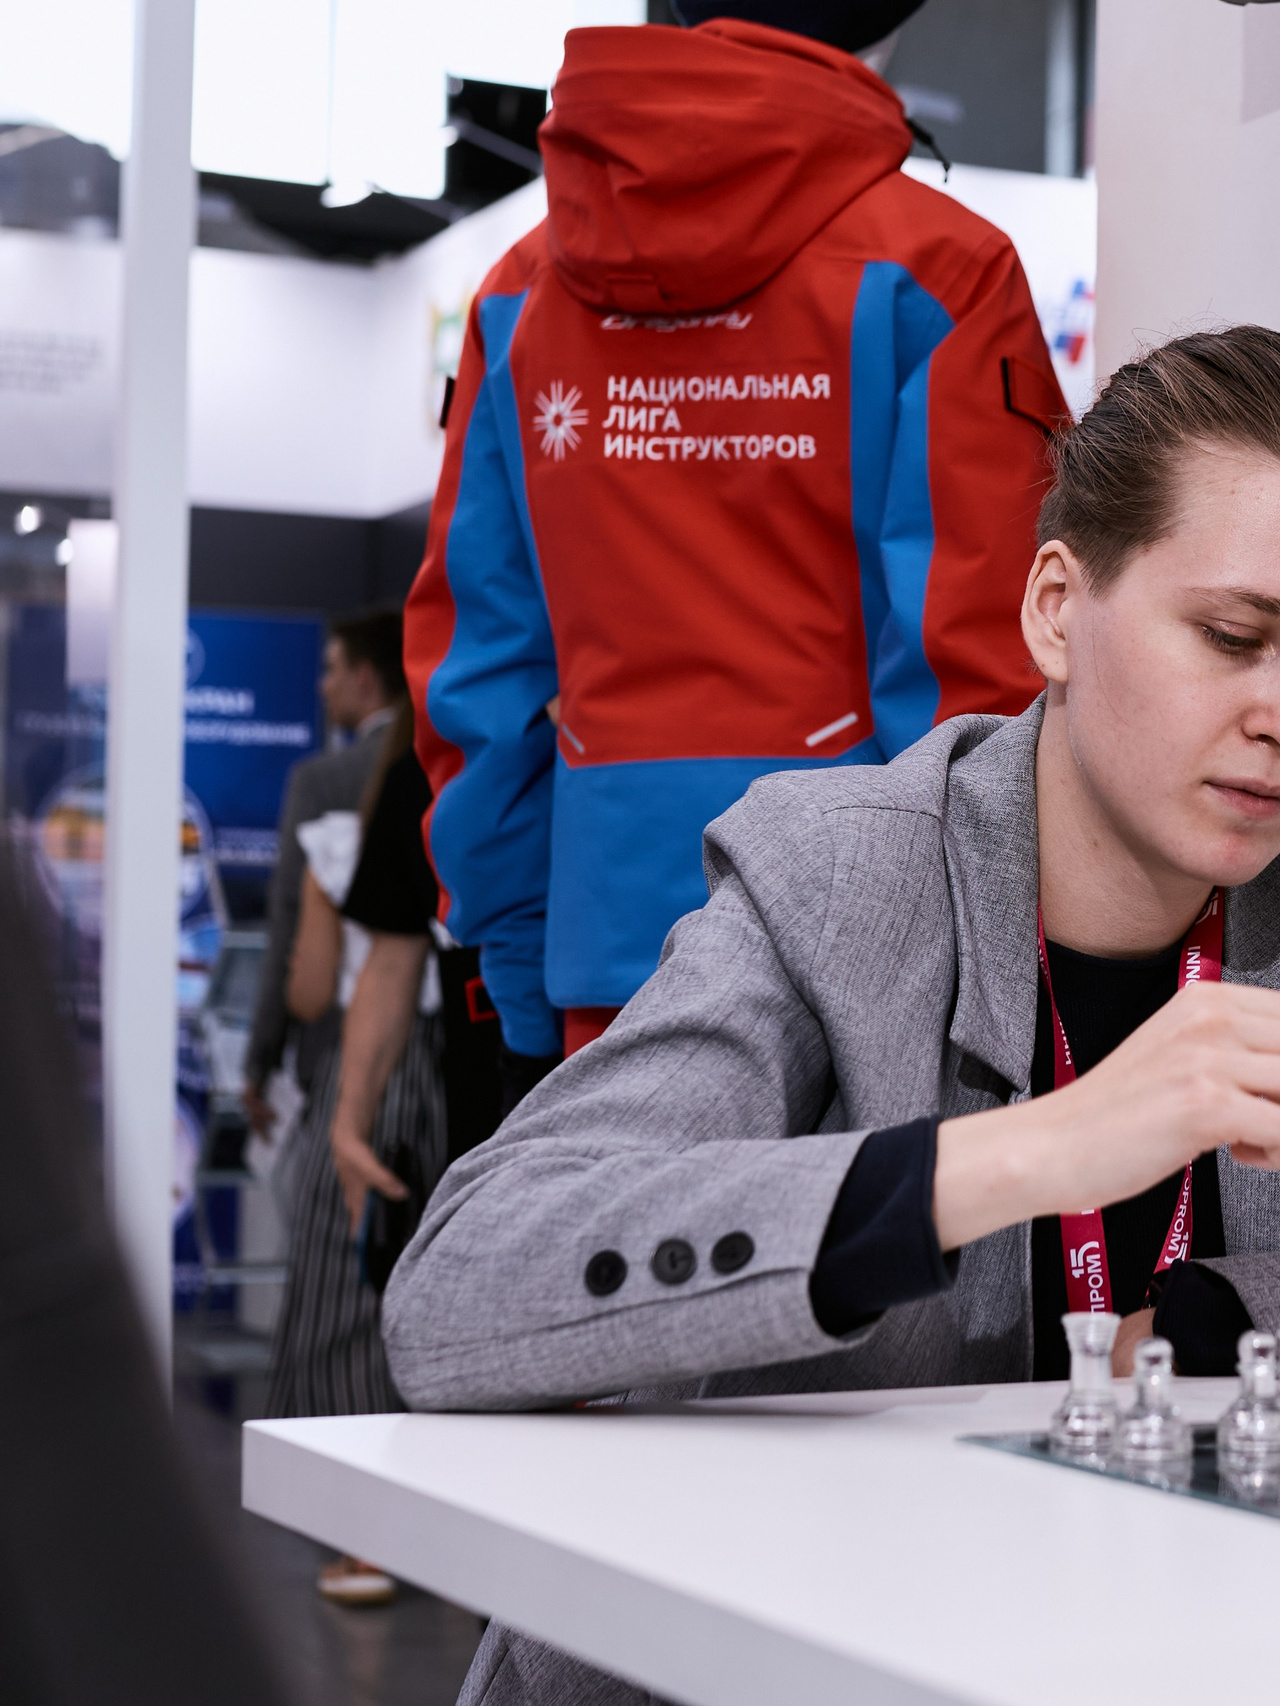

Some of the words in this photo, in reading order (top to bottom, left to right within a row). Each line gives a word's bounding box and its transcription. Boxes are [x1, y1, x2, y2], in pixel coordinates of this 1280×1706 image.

[607, 374, 831, 406] НАЦИОНАЛЬНАЯ
[602, 405, 681, 432] ЛИГА
[604, 433, 817, 462] ИНСТРУКТОРОВ
